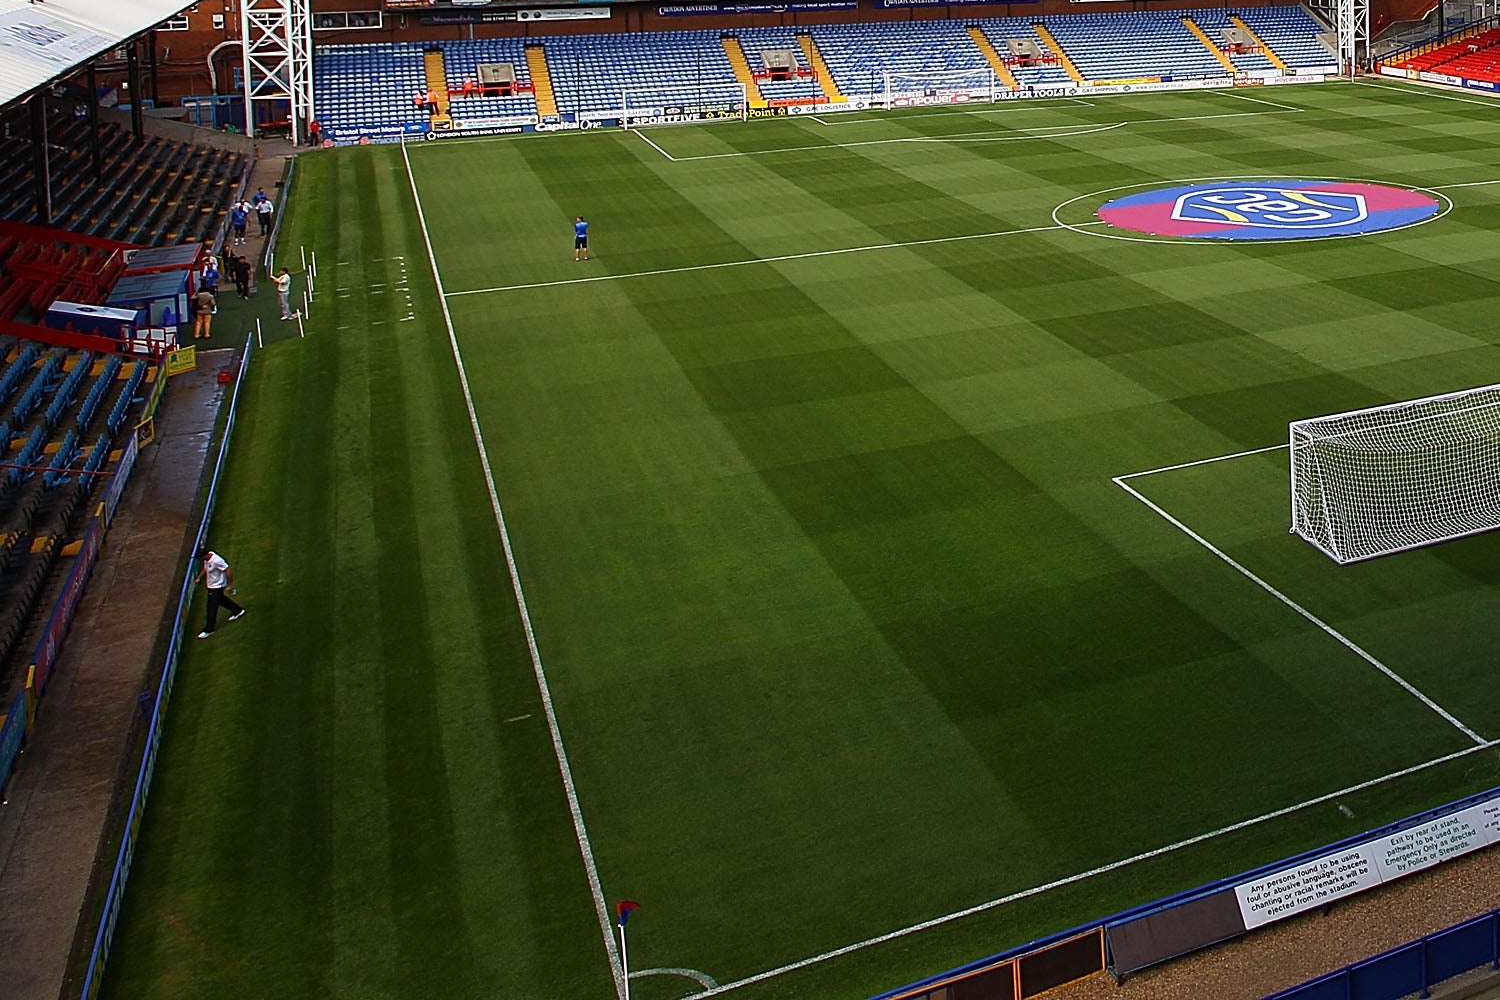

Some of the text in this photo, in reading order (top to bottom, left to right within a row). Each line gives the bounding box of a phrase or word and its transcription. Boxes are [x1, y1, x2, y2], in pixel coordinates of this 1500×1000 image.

[910, 95, 952, 104] npower
[995, 90, 1032, 100] DRAPER
[1033, 88, 1064, 98] TOOLS
[534, 120, 579, 132] Capital
[580, 120, 602, 130] One
[632, 113, 700, 125] SPORTFIVE
[1384, 849, 1422, 866] Emergency
[1424, 842, 1438, 852] Only
[1450, 828, 1476, 843] directed
[1386, 842, 1414, 857] pathway
[1435, 830, 1452, 840] used
[1390, 837, 1404, 846] Exit
[1416, 828, 1428, 837] rear
[1431, 824, 1438, 832] of
[1408, 855, 1428, 867] Police
[1438, 840, 1470, 856] Stewards.
[1246, 893, 1260, 904] foul
[1274, 881, 1300, 894] abusive
[1338, 860, 1368, 872] obscene
[1251, 885, 1264, 894] Any
[1266, 874, 1296, 888] persons
[1298, 866, 1318, 877] found
[1340, 852, 1360, 863] using
[1252, 898, 1282, 912] chanting
[1294, 885, 1314, 896] racial
[1316, 876, 1344, 890] remarks
[1346, 870, 1358, 878] will
[1268, 880, 1358, 916] ejected from the stadium.
